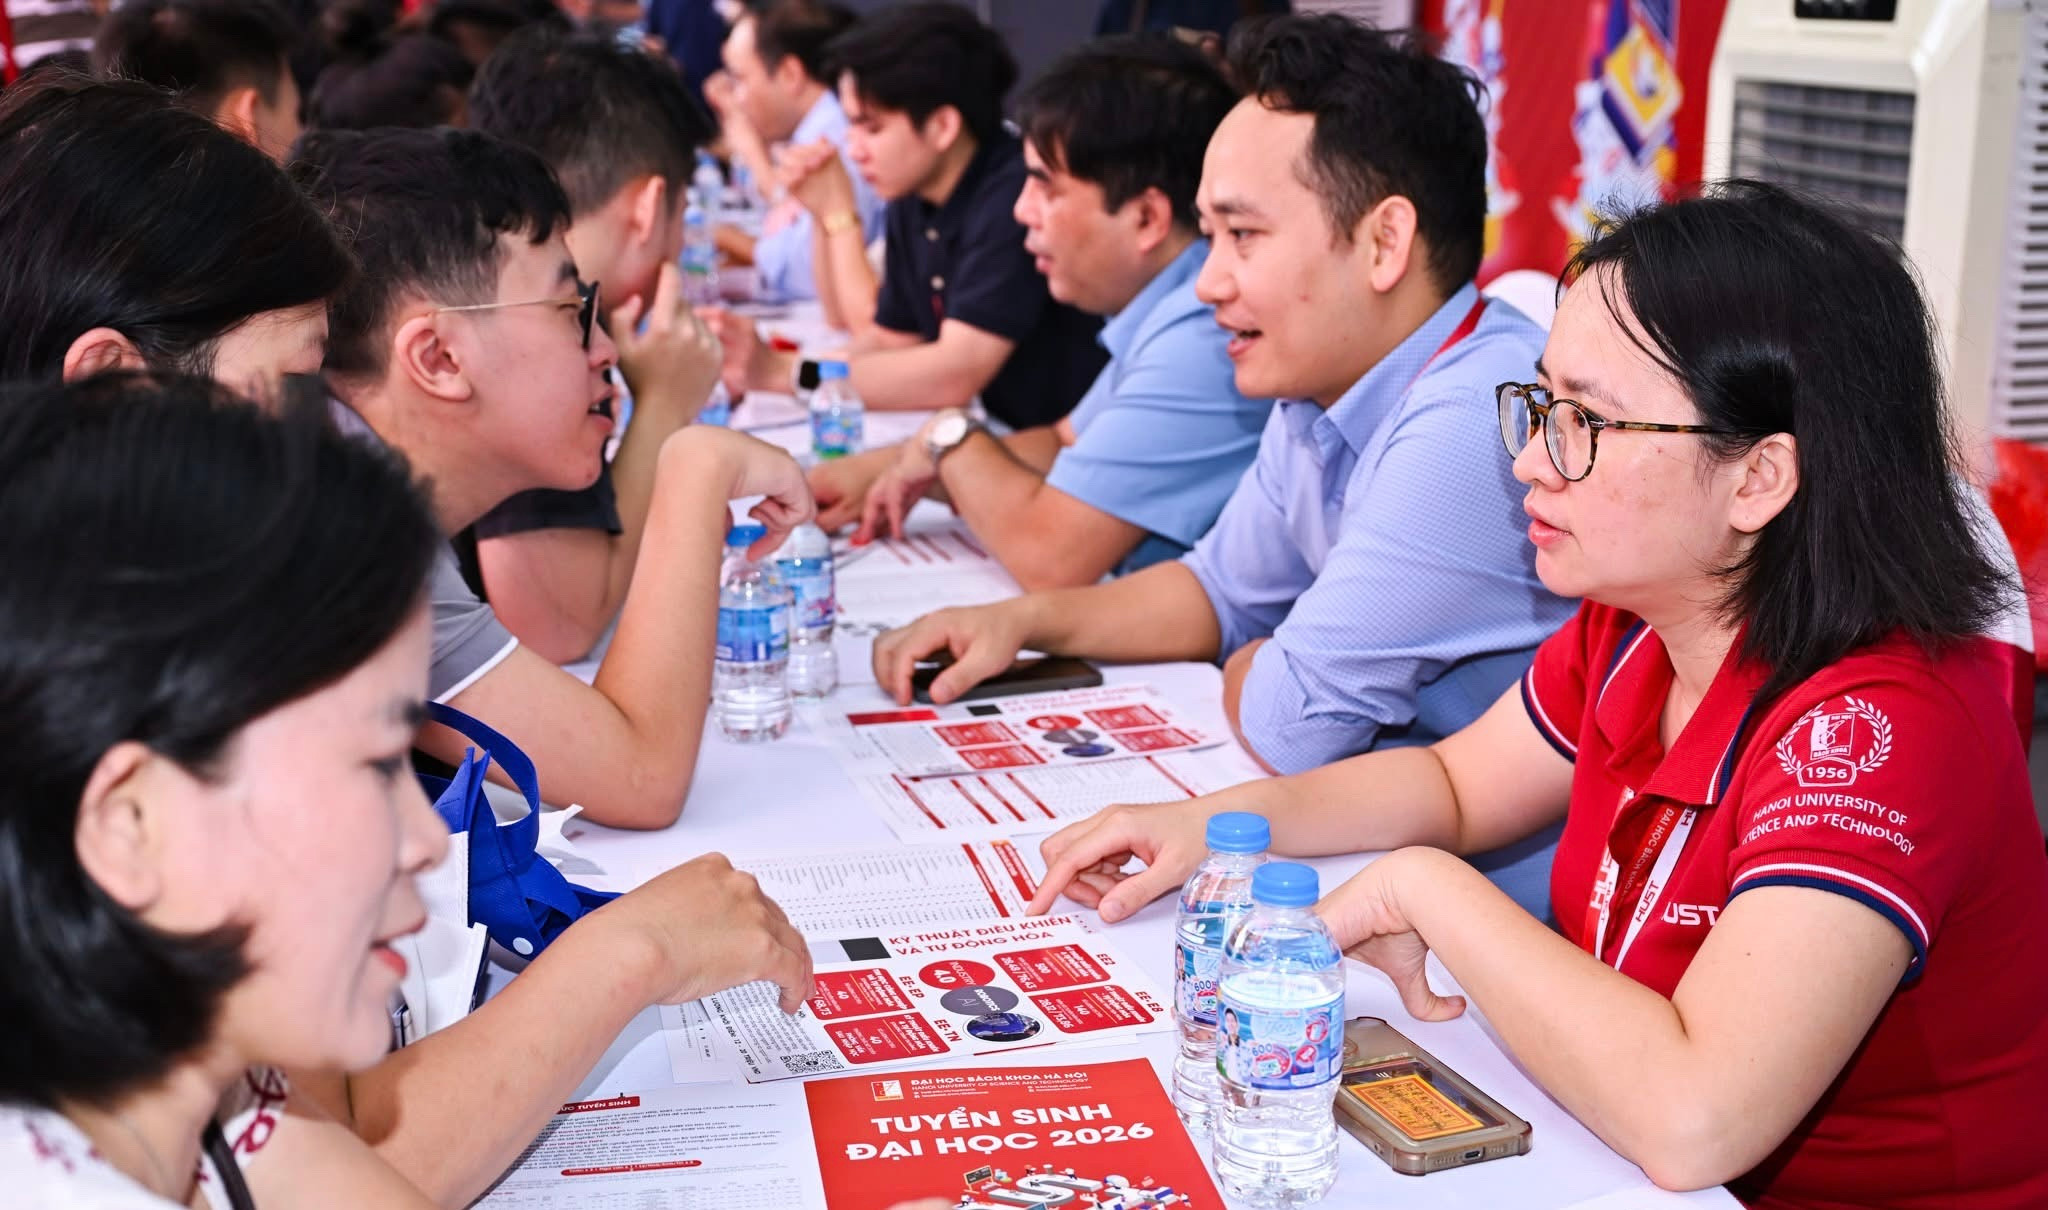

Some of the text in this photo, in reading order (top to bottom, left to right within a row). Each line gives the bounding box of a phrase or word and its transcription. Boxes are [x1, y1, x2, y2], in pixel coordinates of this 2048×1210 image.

[1806, 767, 1848, 779] 1956
[1753, 793, 1908, 826] HANOI UNIVERSITY OF
[1784, 814, 1819, 828] AND
[1822, 813, 1915, 856] TECHNOLOGY
[1635, 880, 1660, 923] HUST
[1661, 901, 1720, 927] UST
[917, 928, 971, 942] THUẬT
[951, 935, 1008, 950] ĐỘNG
[1097, 953, 1116, 967] EE2
[1194, 979, 1212, 992] 600
[833, 989, 851, 1000] 40
[1072, 1004, 1092, 1015] 140
[866, 1034, 884, 1044] 40
[1252, 1043, 1273, 1057] 600
[935, 1077, 964, 1086] HỌC
[967, 1073, 1002, 1083] BÁCH
[1005, 1073, 1040, 1082] KHOA
[937, 1082, 977, 1090] UNIVERSITY
[1039, 1078, 1089, 1086] TECHNOLOGY
[608, 1099, 631, 1107] SINH
[871, 1103, 1112, 1134] TUYỂN SINH
[845, 1122, 1154, 1161] ĐẠI HỌC 2026
